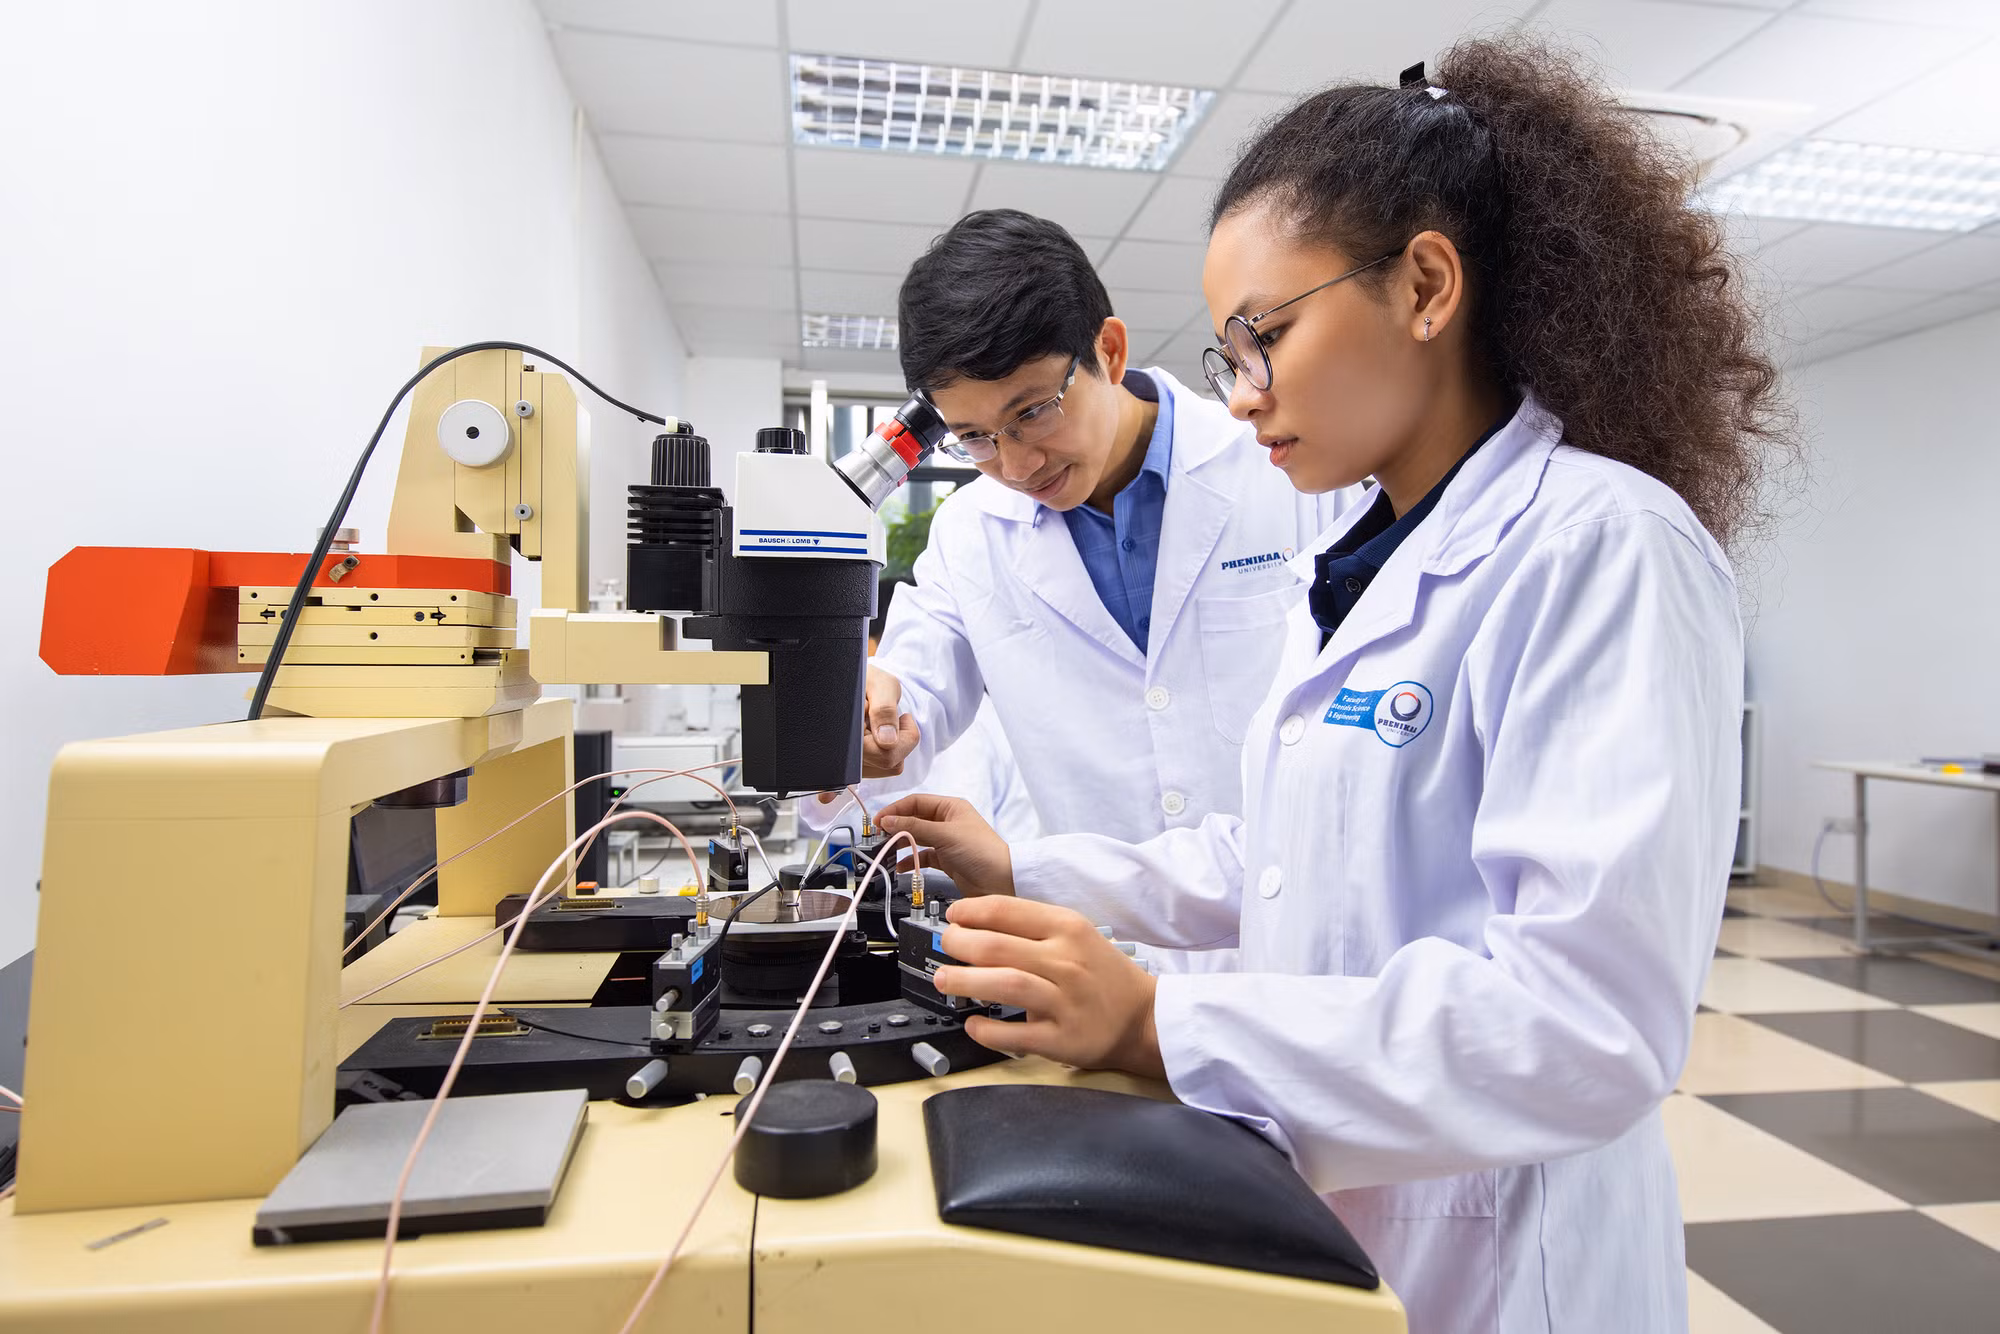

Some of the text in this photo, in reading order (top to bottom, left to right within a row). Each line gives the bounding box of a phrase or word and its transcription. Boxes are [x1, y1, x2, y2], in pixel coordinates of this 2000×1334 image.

[1221, 552, 1281, 570] PHENIKAA
[1238, 561, 1282, 574] UNIVERSITY
[1342, 695, 1361, 704] Faculty
[1331, 703, 1352, 712] aterials
